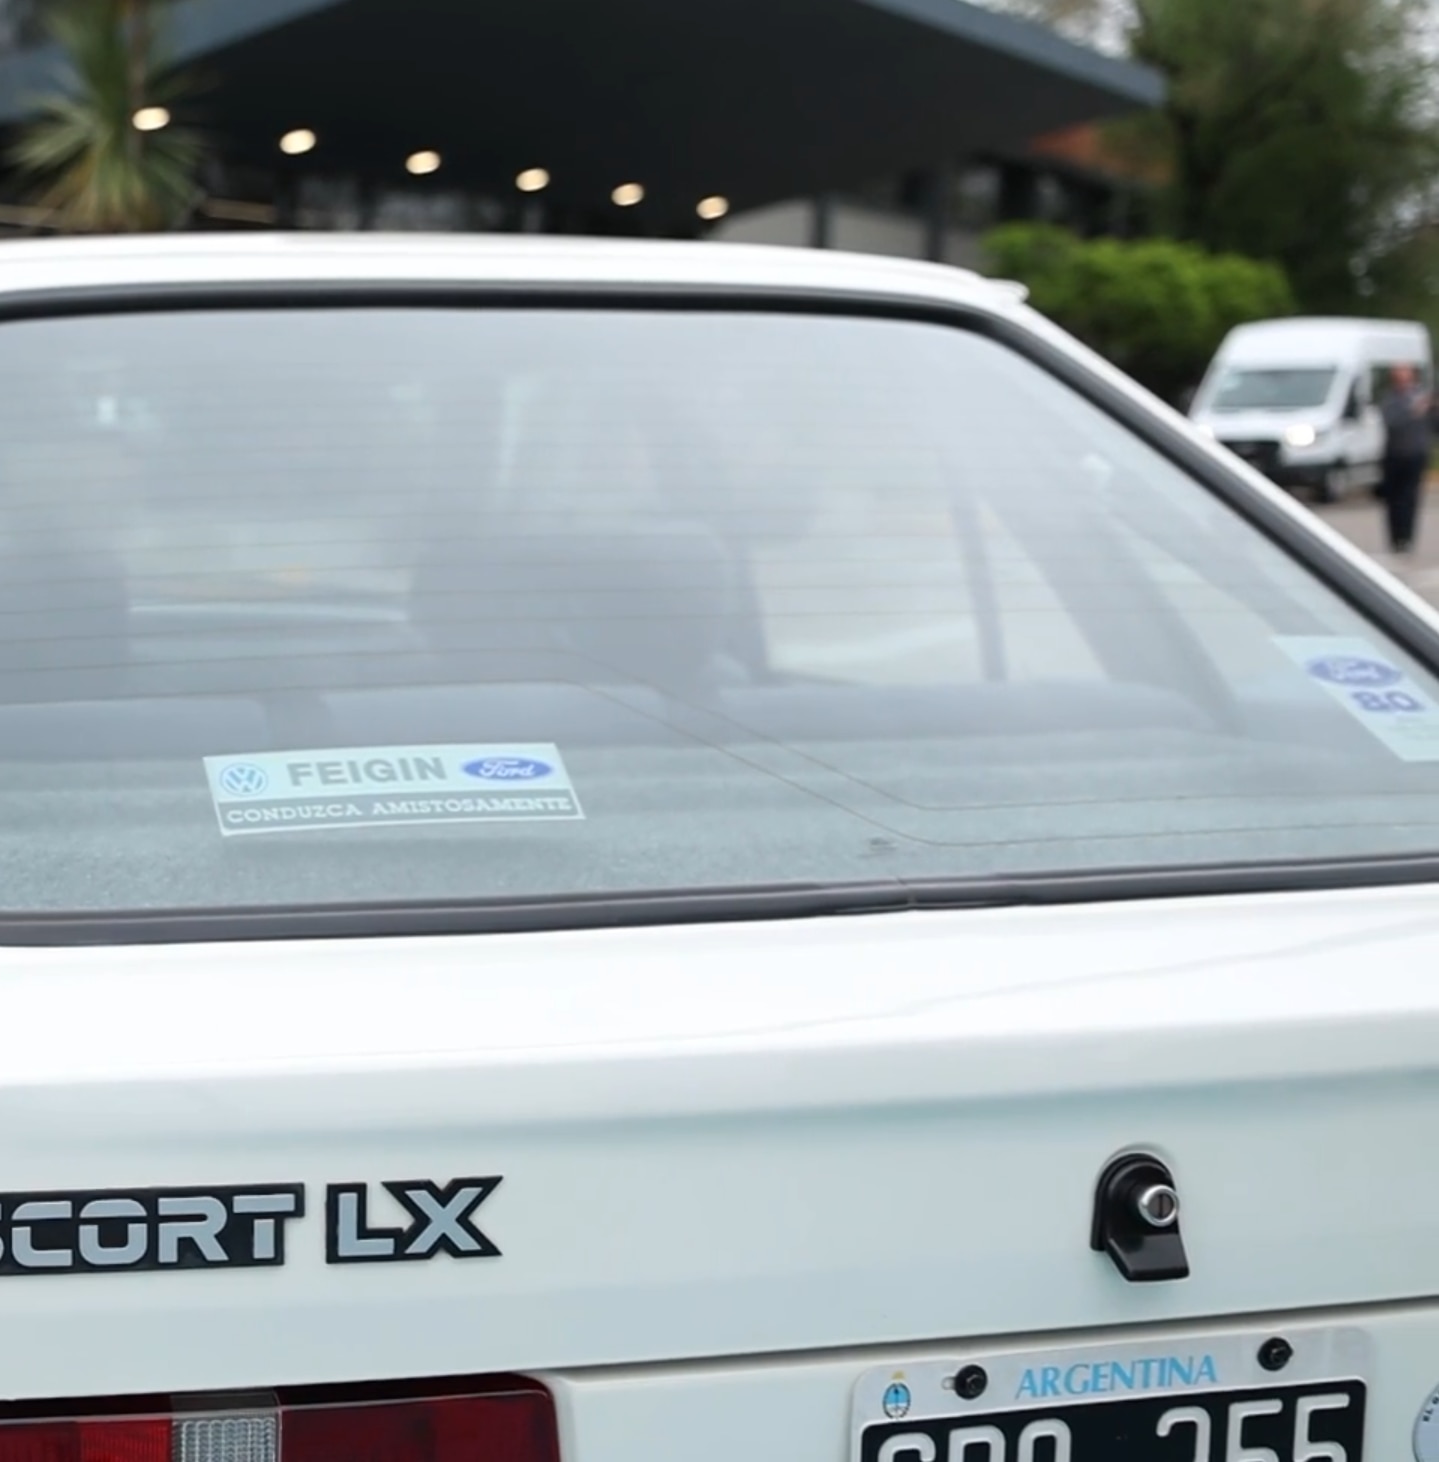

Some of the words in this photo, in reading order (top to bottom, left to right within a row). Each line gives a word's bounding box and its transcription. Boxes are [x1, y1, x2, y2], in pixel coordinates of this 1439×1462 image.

[287, 756, 447, 787] FEIGIN
[479, 760, 537, 777] Ford
[226, 803, 363, 824] CONDUZCA
[372, 797, 572, 815] AMISTOSAMENTE
[337, 1187, 484, 1257] LX
[1015, 1355, 1218, 1399] ARGENTINA
